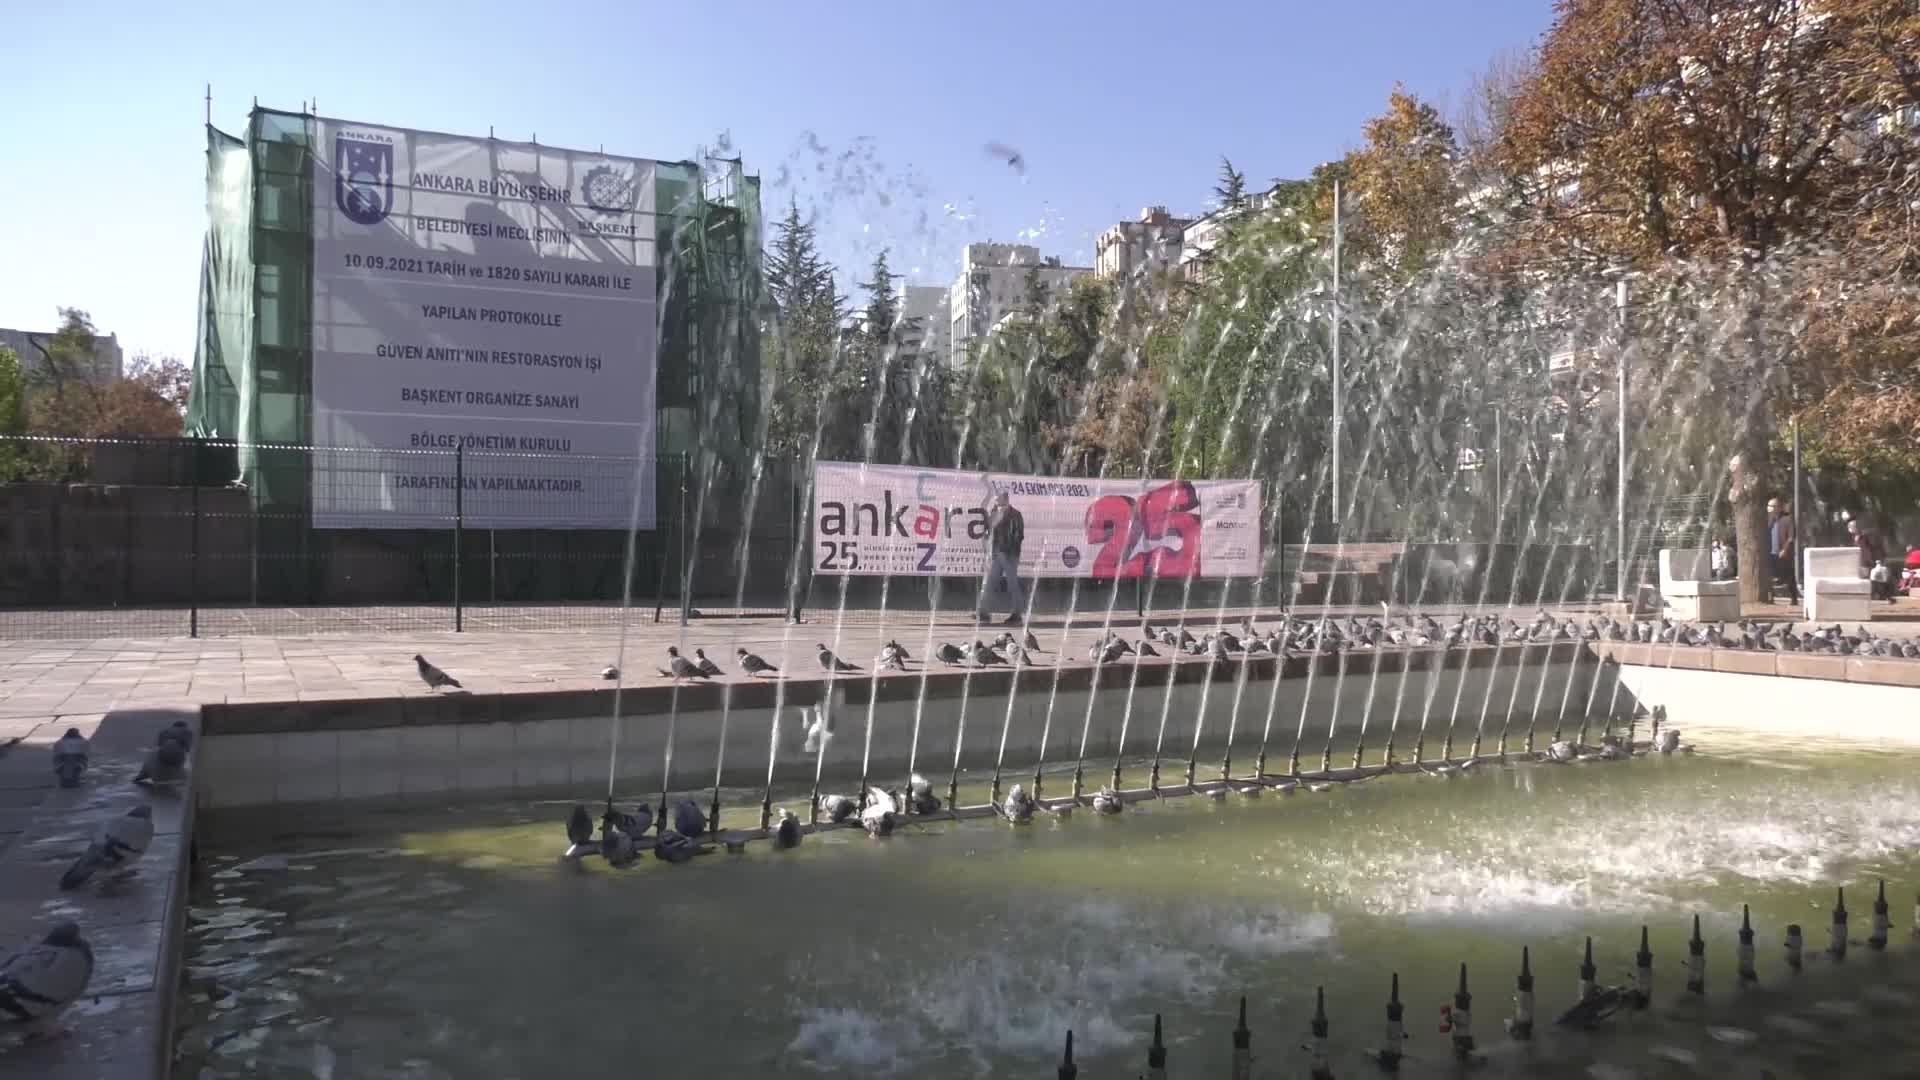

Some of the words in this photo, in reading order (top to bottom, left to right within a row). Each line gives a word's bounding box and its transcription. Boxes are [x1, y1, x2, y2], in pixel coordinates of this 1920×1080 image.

[413, 173, 474, 192] ANKARA
[417, 217, 493, 238] BELEDİYESİ
[344, 253, 424, 273] 10.09.2021
[427, 260, 466, 277] TARİH
[469, 267, 483, 278] ve
[487, 266, 520, 281] 1820
[524, 269, 561, 285] SAYILI
[565, 272, 609, 288] KARARI
[613, 273, 631, 290] İLE
[422, 305, 477, 323] YAPILAN
[481, 308, 561, 327] PROTOKOLLE
[492, 351, 581, 369] RESTORASYON
[402, 388, 462, 405] BAŞKENT
[466, 390, 532, 408] ORGANİZE
[536, 393, 579, 409] SANAYİ
[411, 431, 456, 448] BÖLGE
[459, 433, 516, 450] YÖNETİM
[520, 438, 571, 452] KURULU
[395, 475, 477, 490] TARAFINDAN
[1066, 484, 1090, 497] 2021
[820, 490, 989, 540] ankara
